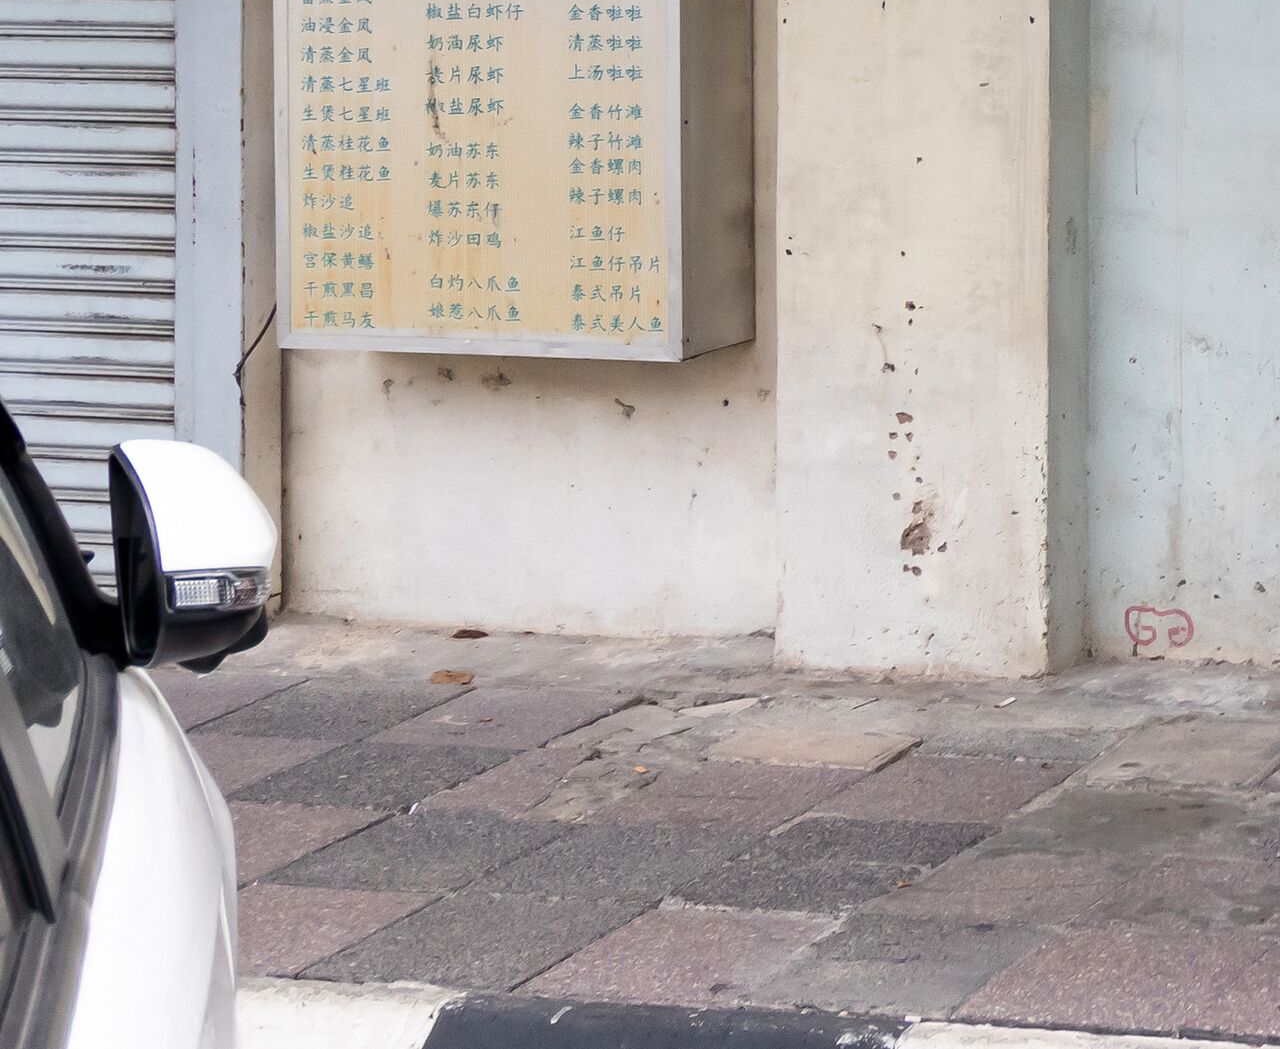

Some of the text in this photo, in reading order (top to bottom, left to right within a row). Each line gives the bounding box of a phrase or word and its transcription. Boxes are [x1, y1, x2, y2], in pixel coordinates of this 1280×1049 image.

[425, 3, 524, 20] 椒盐白虾仔
[301, 17, 373, 33] 油浸金凤
[301, 46, 373, 63] 清蒸金凤
[426, 143, 500, 159] 奶油苏东
[568, 158, 642, 175] 金香螺肉
[429, 171, 500, 189] 麦片苏东
[569, 187, 643, 205] 辣子螺肉
[303, 223, 374, 240] 椒盐沙追
[428, 230, 503, 249] 炸沙田鸡
[570, 226, 625, 242] 江鱼仔
[570, 256, 660, 272] 江鱼仔吊片
[430, 274, 521, 291] 白灼八爪鱼
[571, 284, 642, 303] 泰式吊片
[304, 311, 376, 328] 干煎马友
[429, 303, 521, 321] 娘惹八爪鱼
[572, 313, 664, 332] 泰式美人鱼
